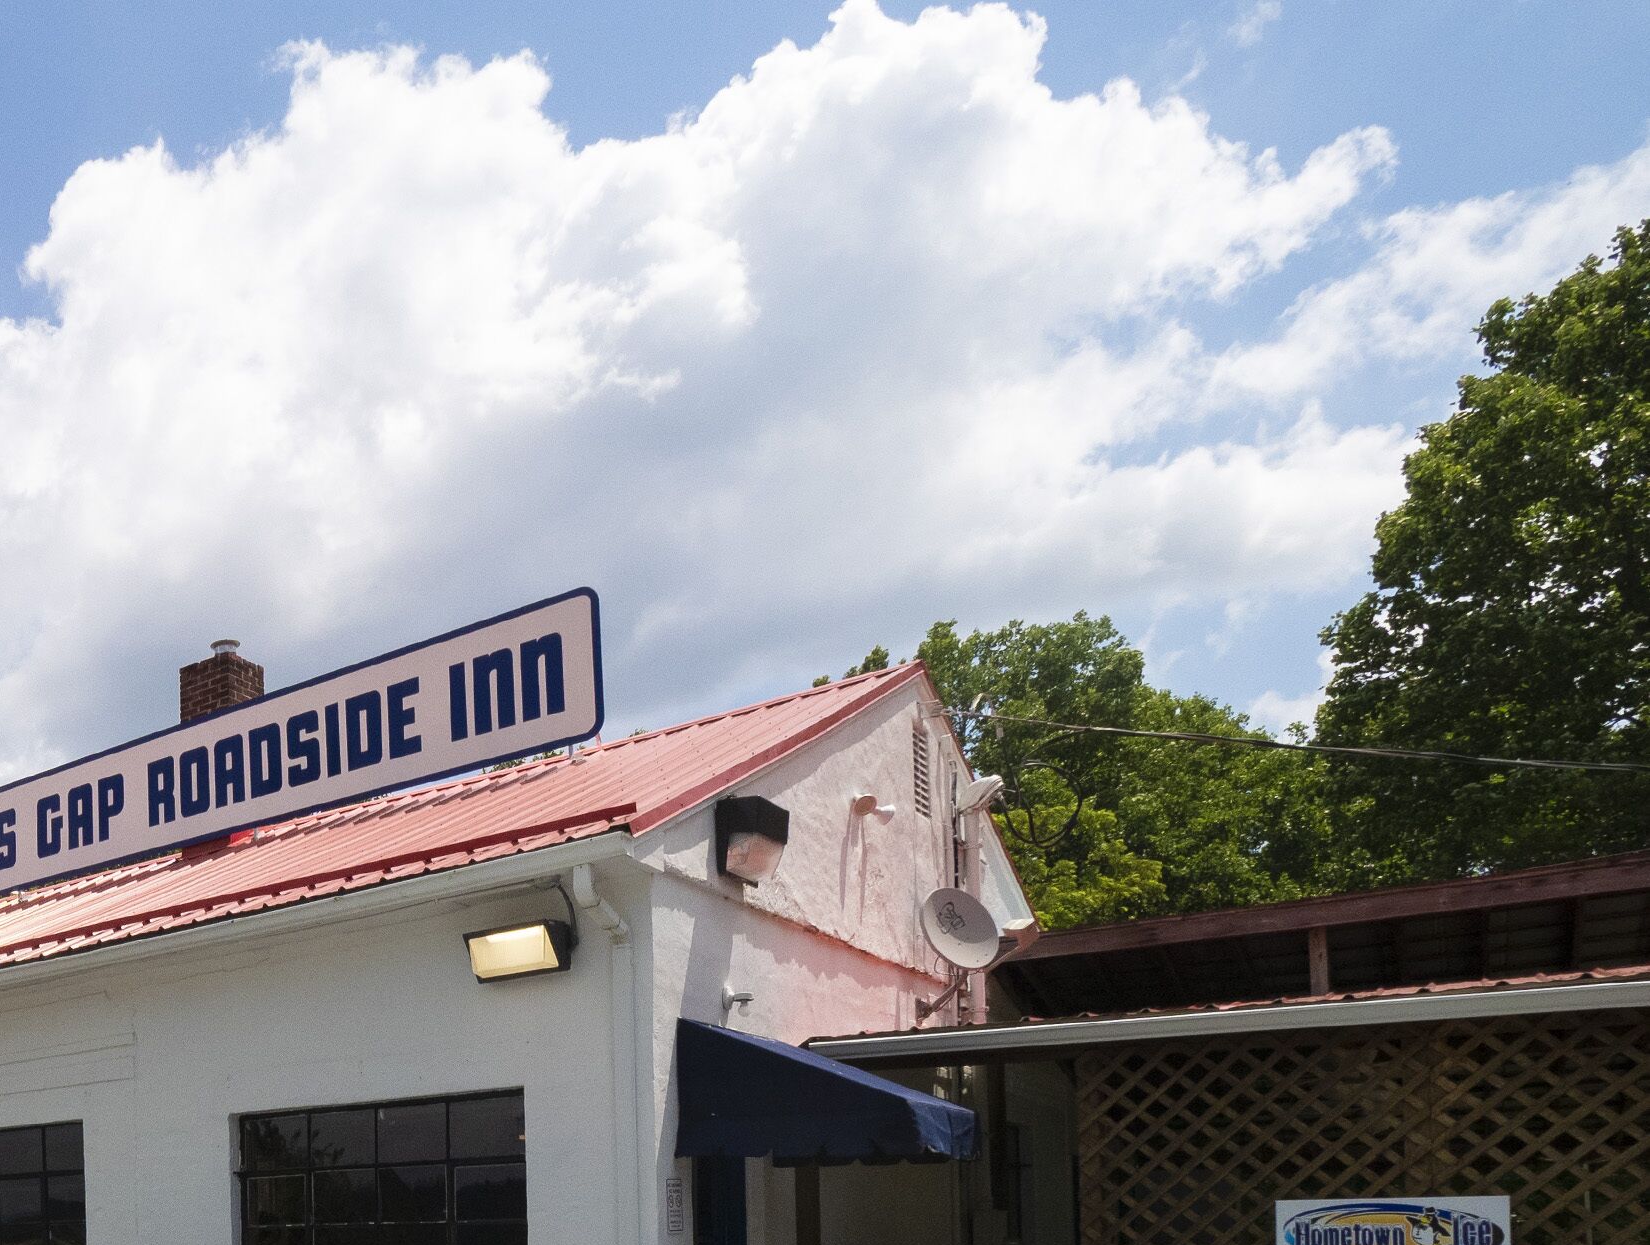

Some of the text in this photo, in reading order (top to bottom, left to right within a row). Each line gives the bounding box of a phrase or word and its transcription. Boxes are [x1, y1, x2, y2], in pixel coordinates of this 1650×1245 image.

[36, 772, 125, 858] GAP
[146, 676, 423, 826] ROADSIDE
[448, 632, 566, 742] INN
